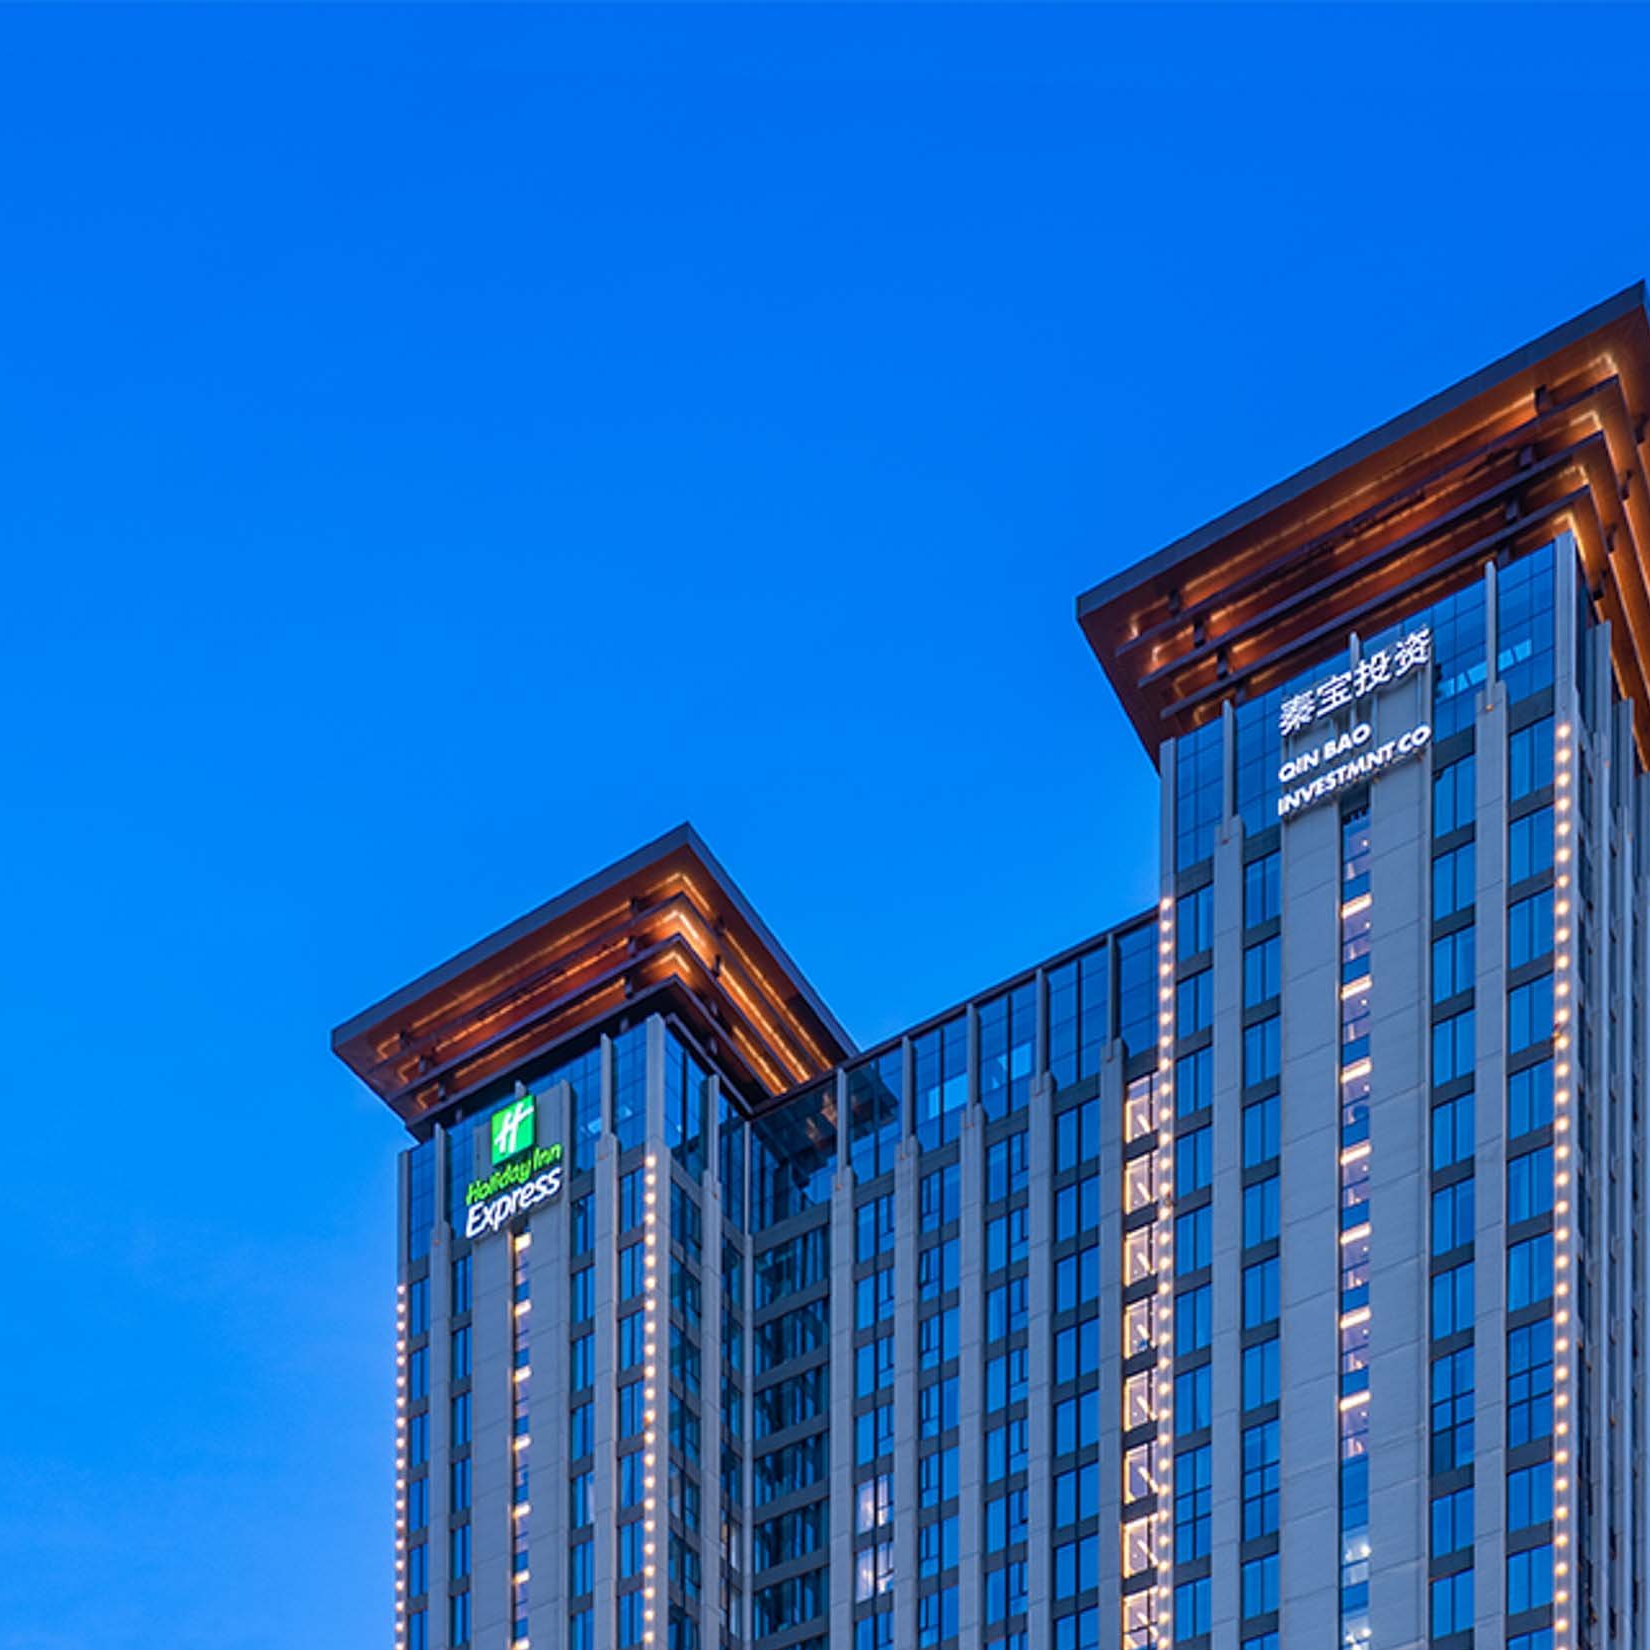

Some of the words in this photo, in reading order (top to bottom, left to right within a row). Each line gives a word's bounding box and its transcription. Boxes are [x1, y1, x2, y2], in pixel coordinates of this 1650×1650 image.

[1279, 627, 1431, 736] 秦宝投资
[1278, 749, 1319, 783] QIN
[1324, 724, 1371, 761] BAO
[1398, 725, 1432, 753] CO
[466, 1158, 532, 1206] Holiday
[533, 1144, 562, 1171] Inn
[466, 1167, 562, 1239] Express
